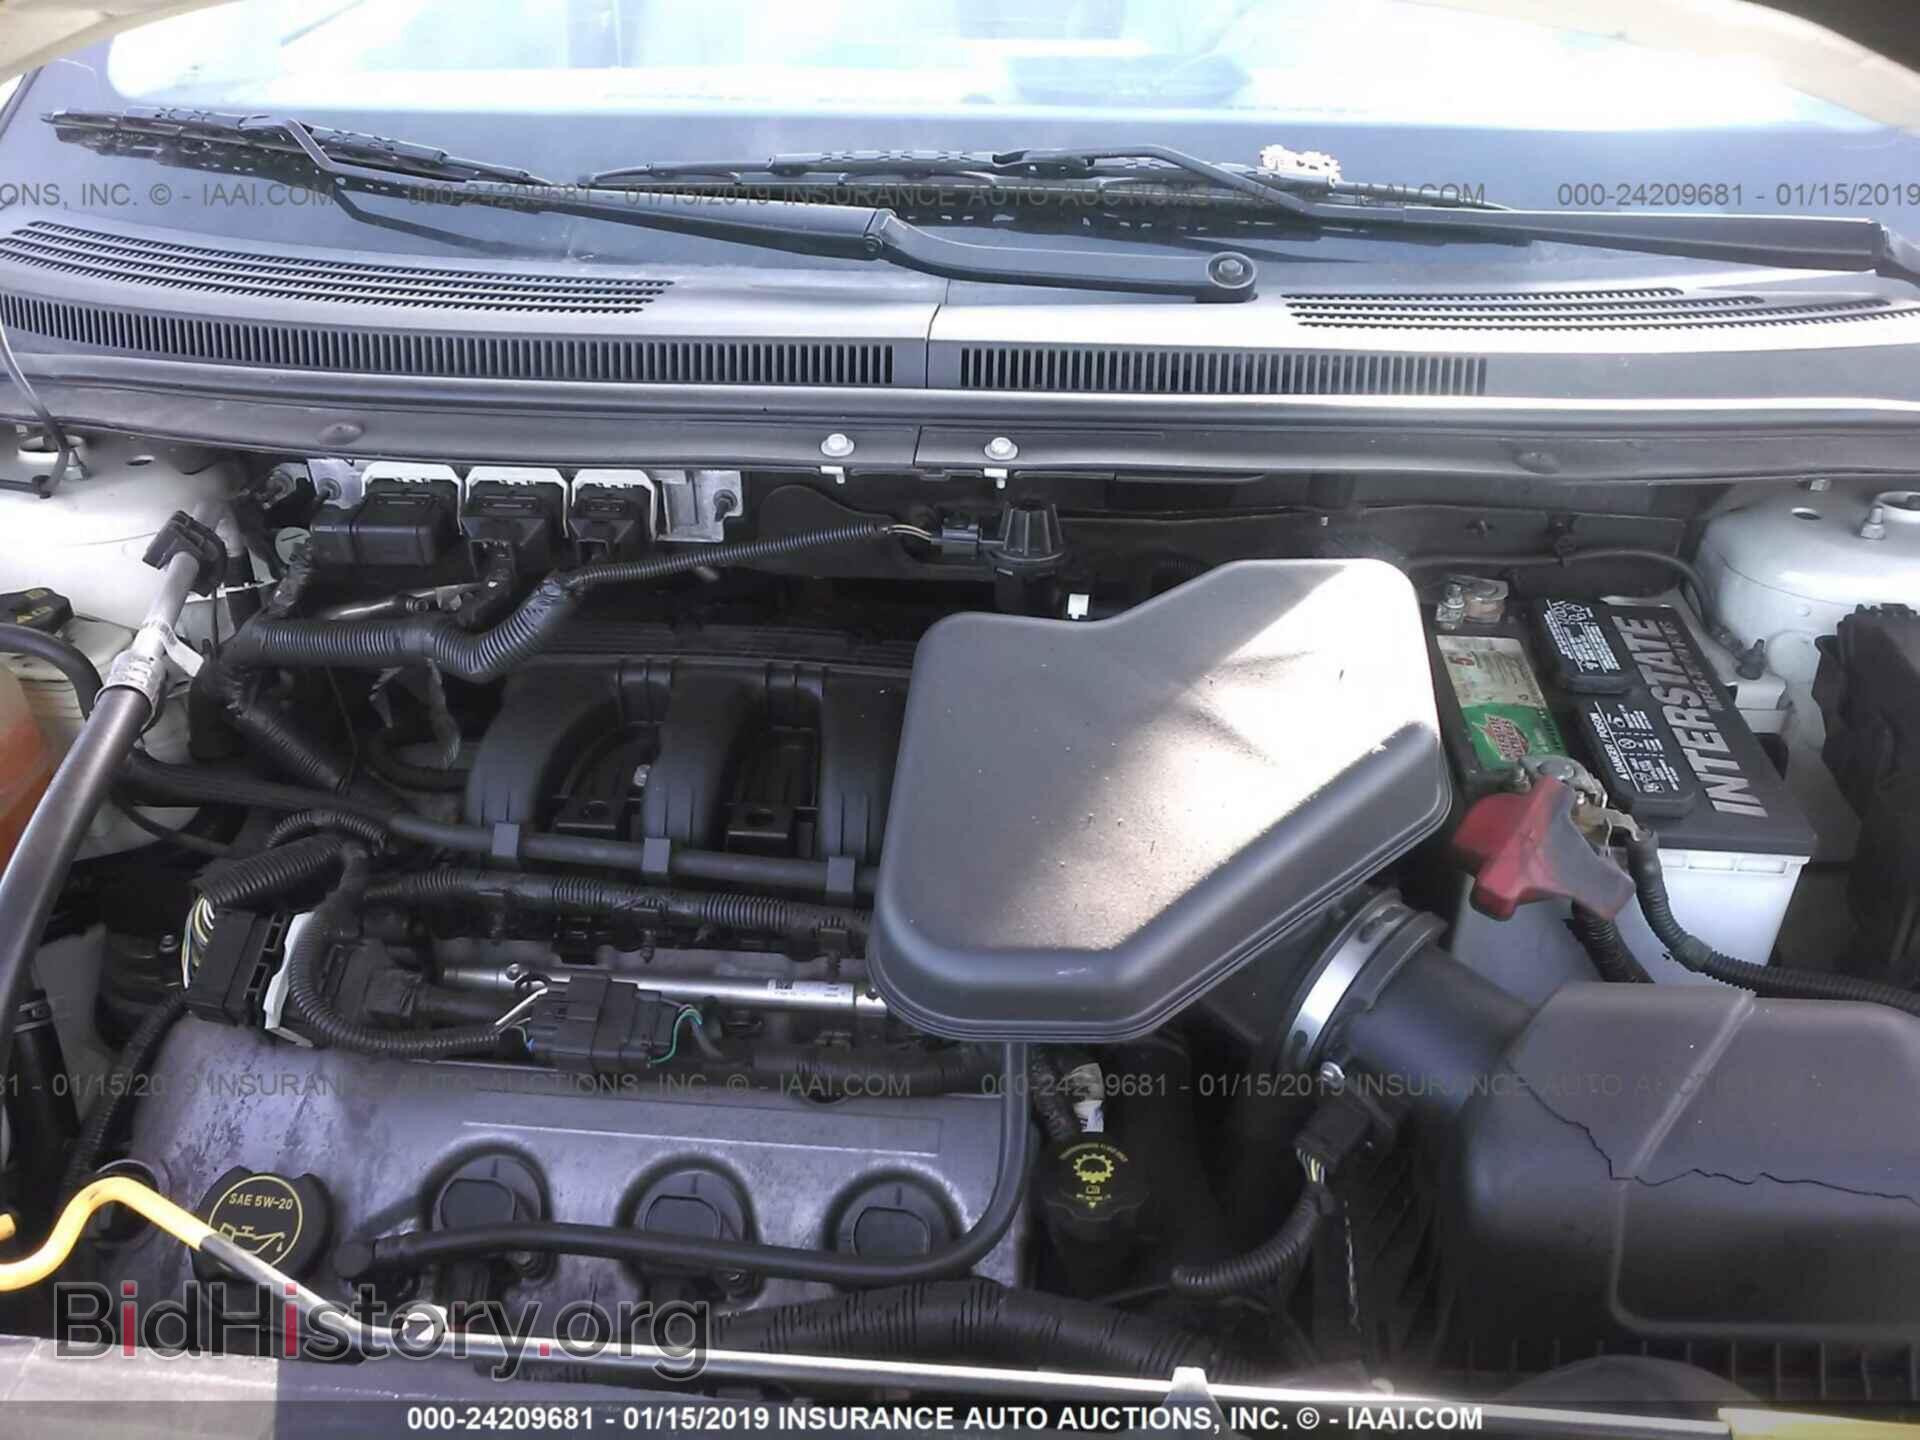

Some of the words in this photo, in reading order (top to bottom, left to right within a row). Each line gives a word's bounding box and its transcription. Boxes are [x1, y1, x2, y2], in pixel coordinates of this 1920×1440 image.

[1588, 712, 1610, 738] POISON
[1610, 616, 1769, 818] INTERSTATE
[1604, 744, 1627, 773] DANGER
[228, 1192, 254, 1207] SAE
[254, 1195, 295, 1211] 5W-20
